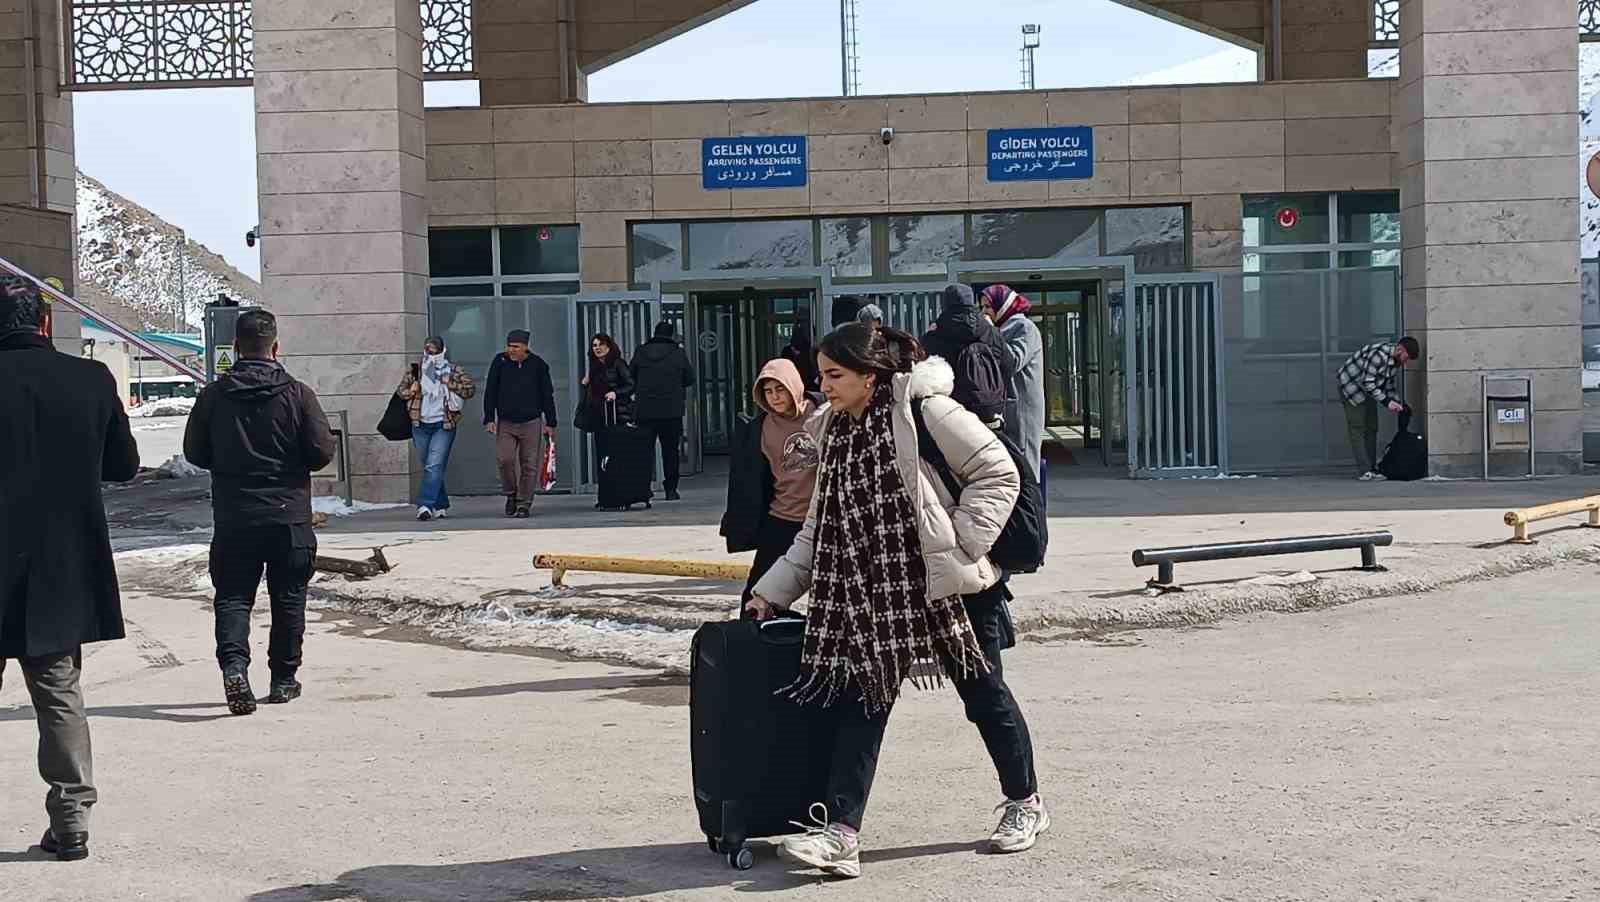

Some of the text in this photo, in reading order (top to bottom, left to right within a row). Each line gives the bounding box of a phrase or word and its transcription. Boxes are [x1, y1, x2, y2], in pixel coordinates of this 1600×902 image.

[1040, 137, 1079, 148] YOLCU
[712, 144, 796, 155] GELEN YOLCU
[992, 150, 1088, 159] DEPARTING PASSENGERS
[749, 157, 801, 165] PASSENGERS
